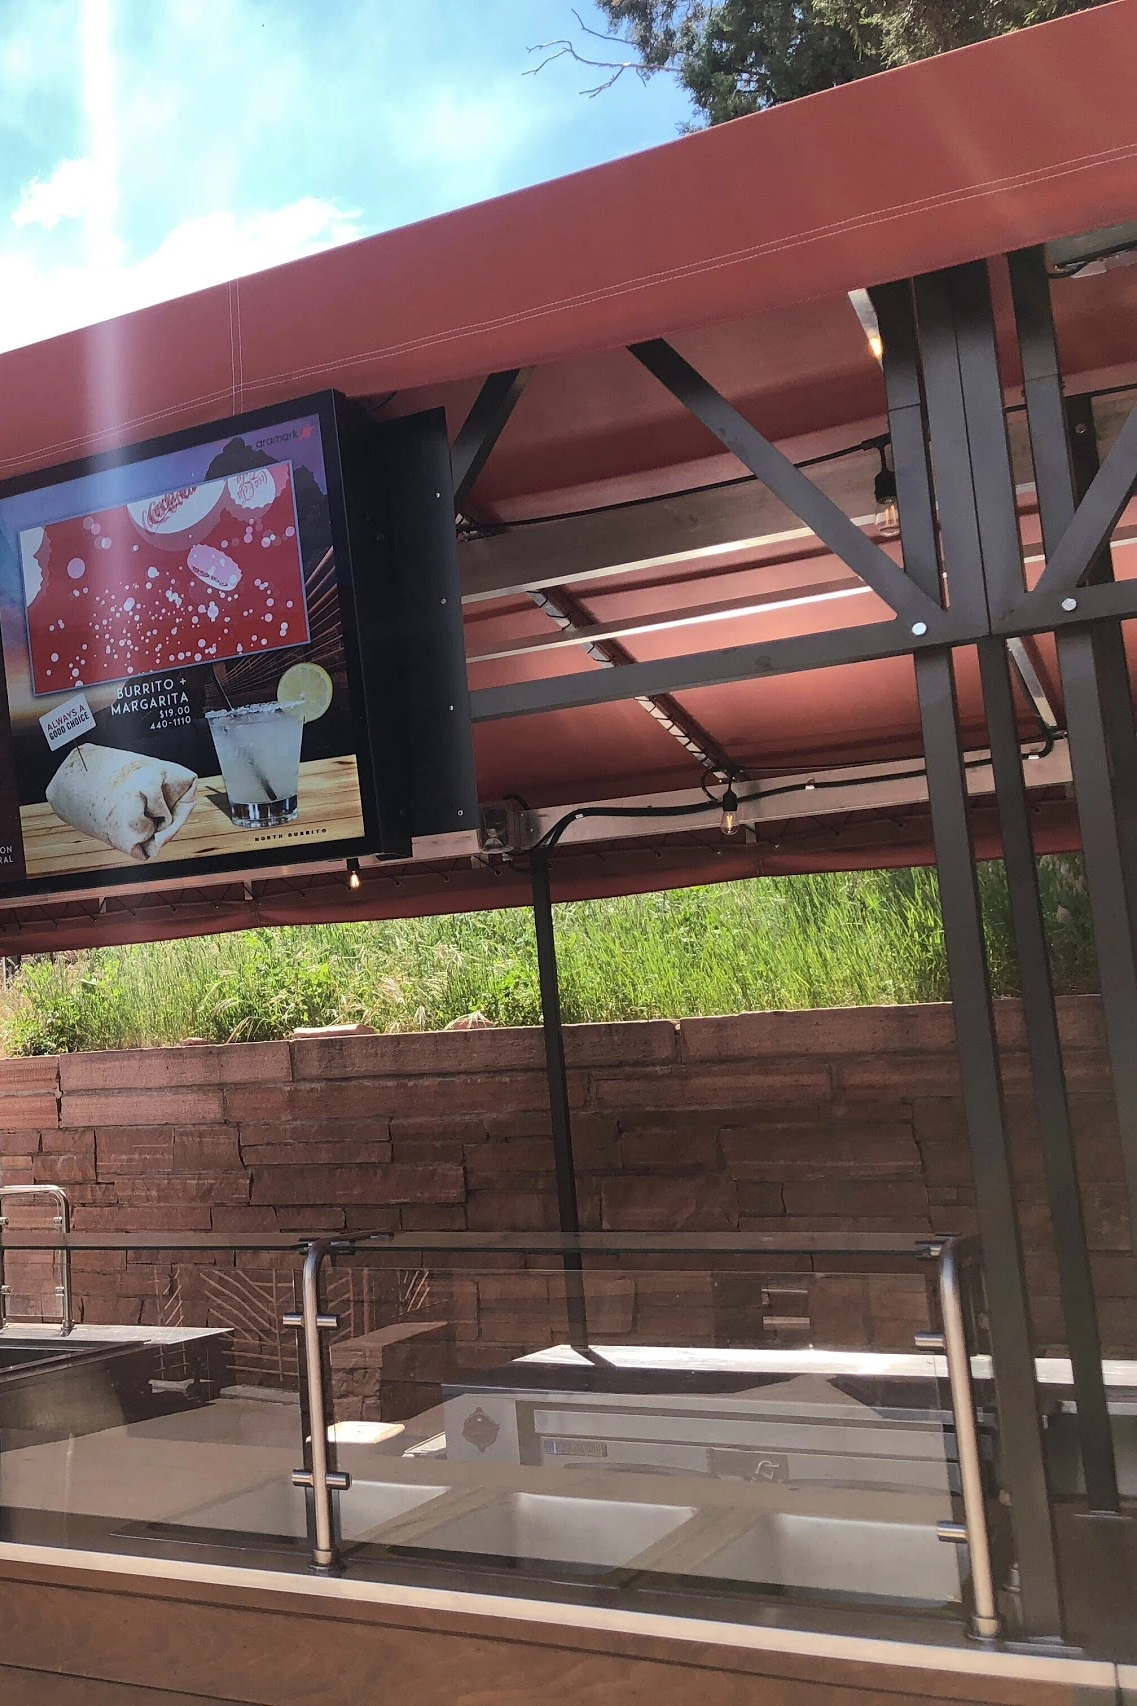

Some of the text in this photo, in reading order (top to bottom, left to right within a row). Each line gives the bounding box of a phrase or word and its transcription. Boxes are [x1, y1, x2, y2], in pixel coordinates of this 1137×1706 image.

[256, 430, 298, 448] aramark
[116, 678, 187, 699] BURRITO +
[111, 692, 189, 715] MARGARITA
[159, 706, 190, 718] $19.00
[47, 709, 78, 731] ALWAYS
[49, 712, 89, 740] GOOD CHOICE
[150, 716, 191, 730] 440-1110
[288, 829, 326, 837] BURRITO
